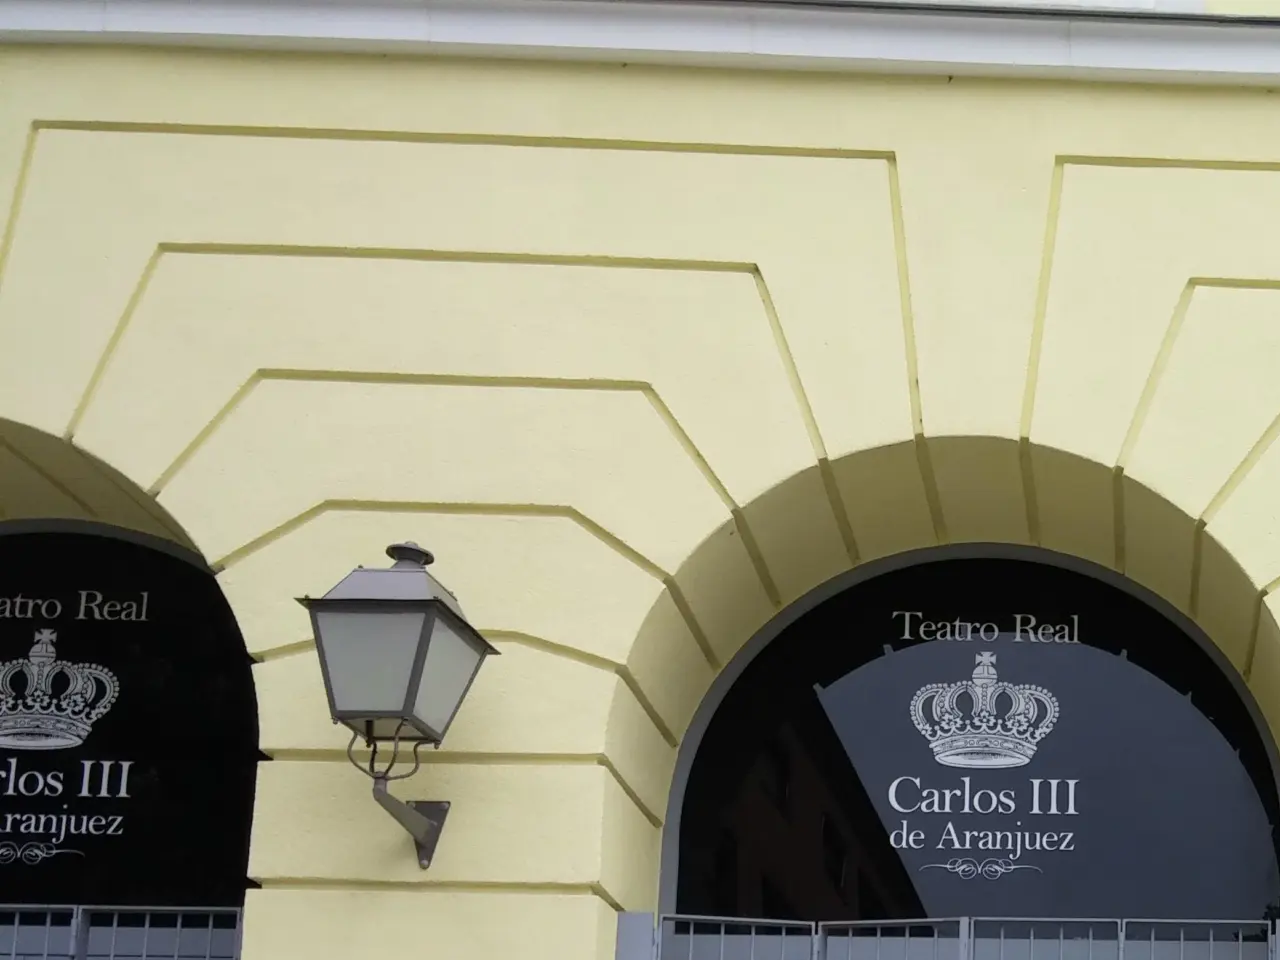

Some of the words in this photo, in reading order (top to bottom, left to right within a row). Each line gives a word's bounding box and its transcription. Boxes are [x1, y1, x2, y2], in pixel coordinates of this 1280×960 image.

[75, 590, 149, 621] Real
[892, 611, 999, 641] Teatro
[1013, 614, 1081, 643] Real
[77, 760, 135, 798] III
[888, 777, 1015, 813] Carlos
[1029, 779, 1080, 814] III
[0, 804, 124, 844] ranjuez
[890, 820, 925, 849] de
[936, 821, 1075, 859] Aranjuez
